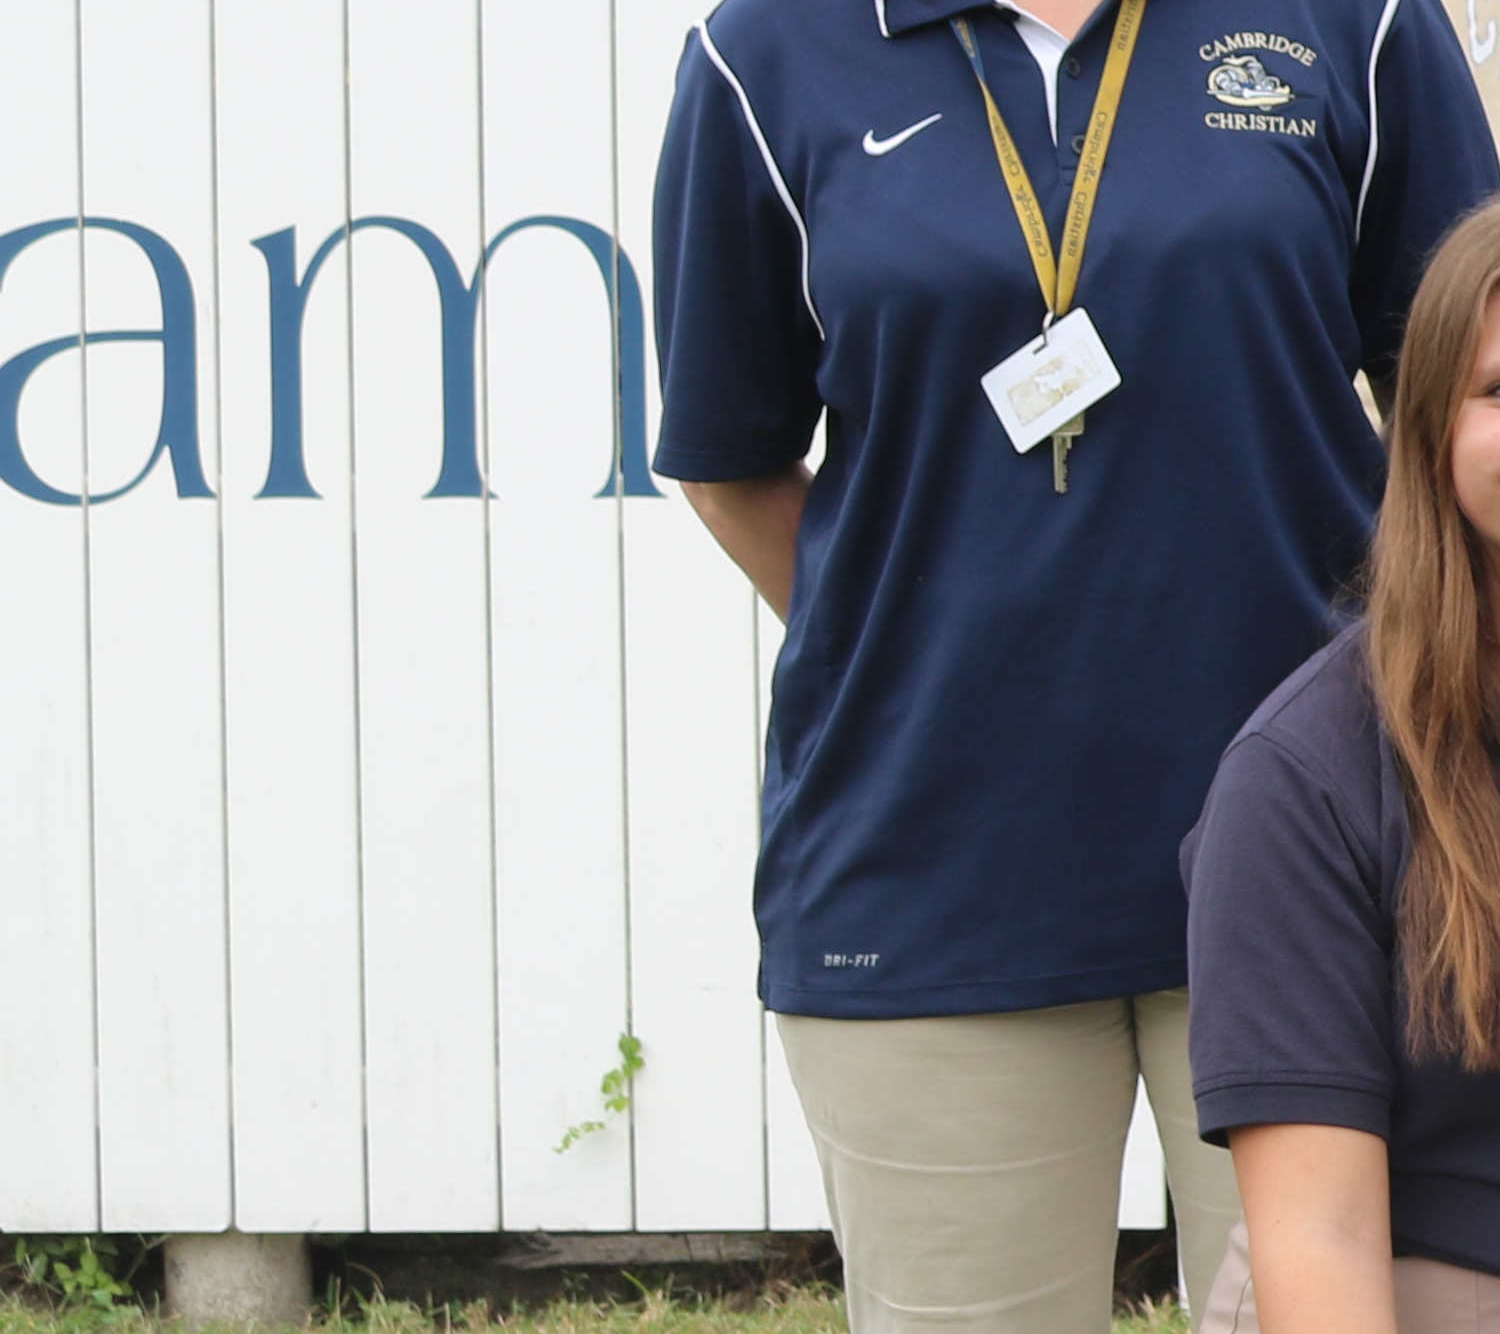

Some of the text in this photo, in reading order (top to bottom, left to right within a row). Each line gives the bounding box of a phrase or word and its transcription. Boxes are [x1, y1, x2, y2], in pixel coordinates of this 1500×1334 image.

[1199, 32, 1317, 67] CAMBRIDGE
[1204, 112, 1317, 137] CHRISTIAN
[824, 953, 880, 967] DRI-FIT
